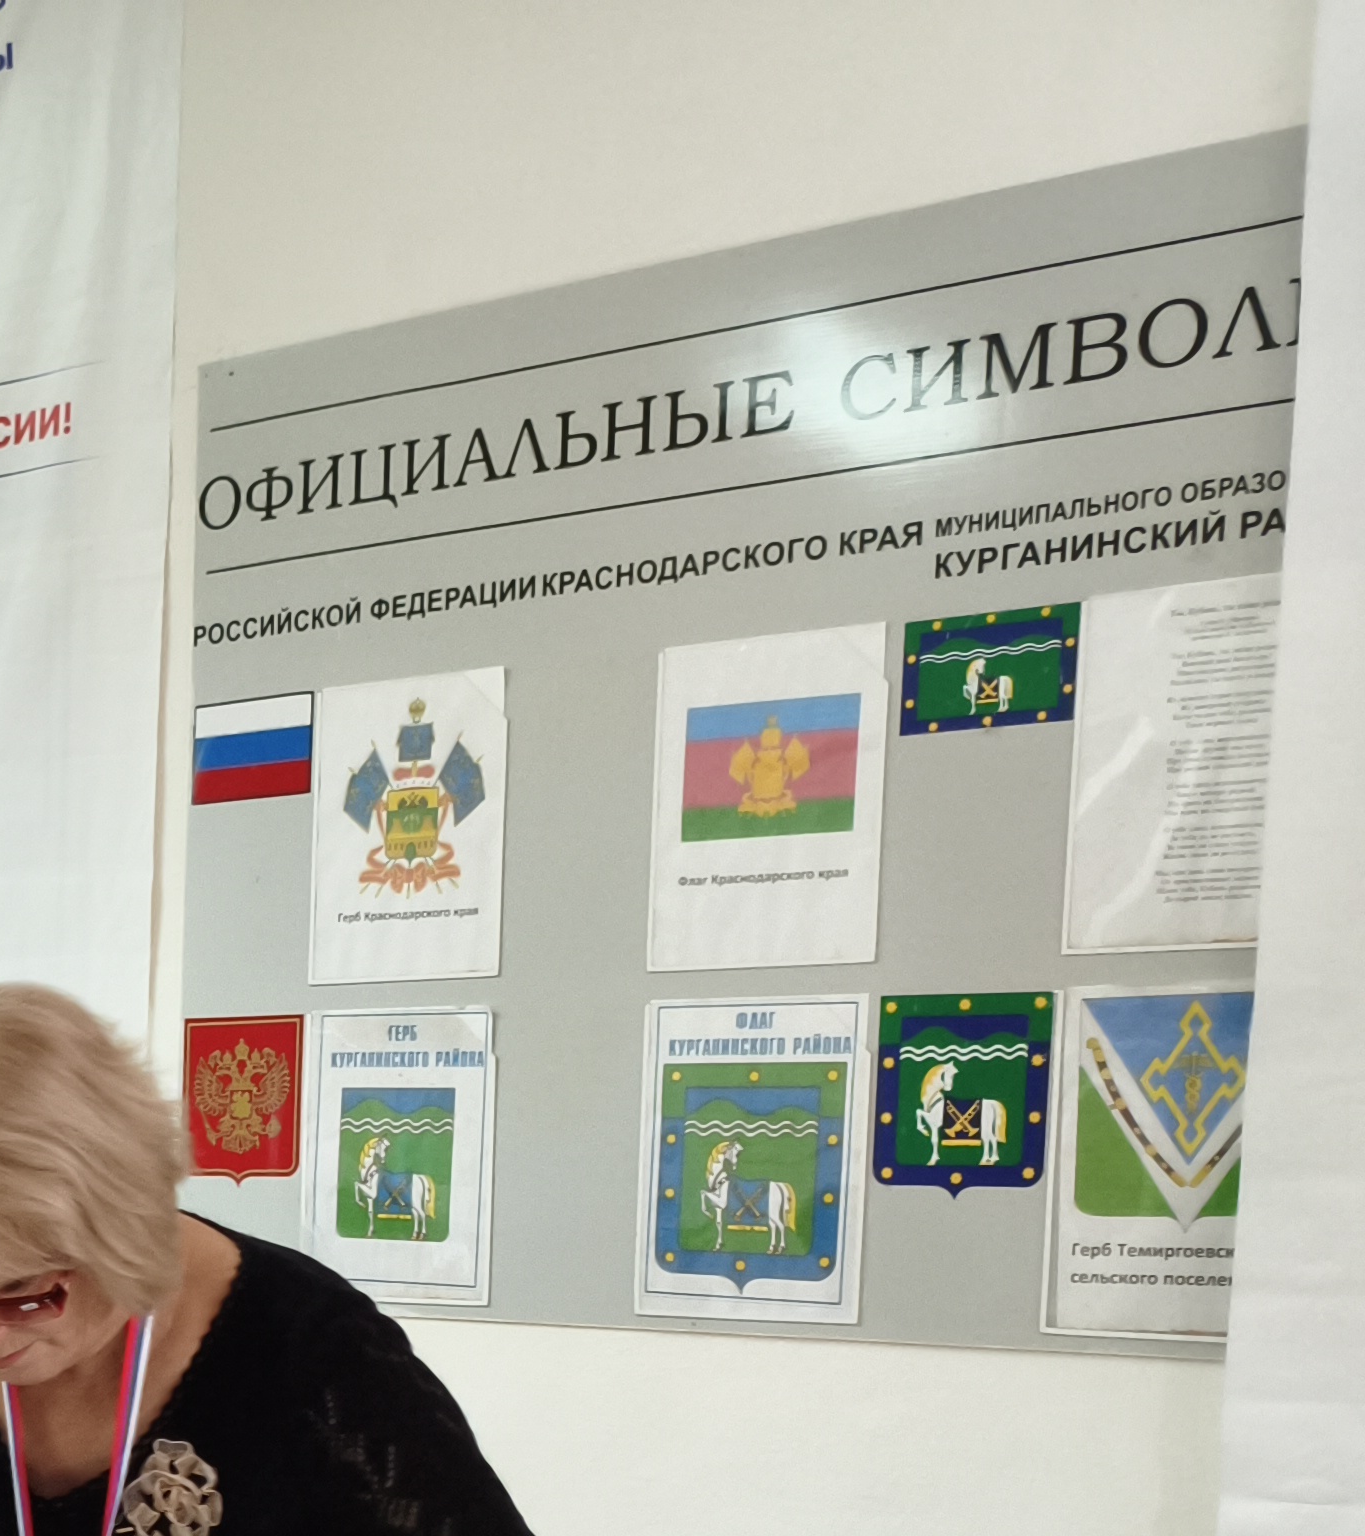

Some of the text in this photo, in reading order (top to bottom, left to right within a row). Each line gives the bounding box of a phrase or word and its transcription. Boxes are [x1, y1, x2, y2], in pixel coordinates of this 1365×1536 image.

[197, 367, 796, 532] ОФИЦИАЛЬНЫЕ
[935, 485, 1173, 538] МУНИЦИПАЛЬНОГО
[934, 508, 1227, 579] КУРГАНИНСКИЙ
[541, 520, 924, 597] КРАСНОДАРСКОГО КРАЯ
[192, 574, 537, 647] РОССИЙСКОЙ ФЕДЕРАЦИИ
[338, 911, 362, 924] Герб
[735, 1011, 776, 1030] ФЛАГ
[388, 1024, 418, 1042] ГЕРБ
[668, 1033, 852, 1057] КУРГАНИНСКОГО РАЙОНА
[331, 1047, 485, 1068] КУРГАНИНСКОГО РАЙОНА
[1071, 1242, 1112, 1259] Герб
[1070, 1272, 1158, 1286] сельского
